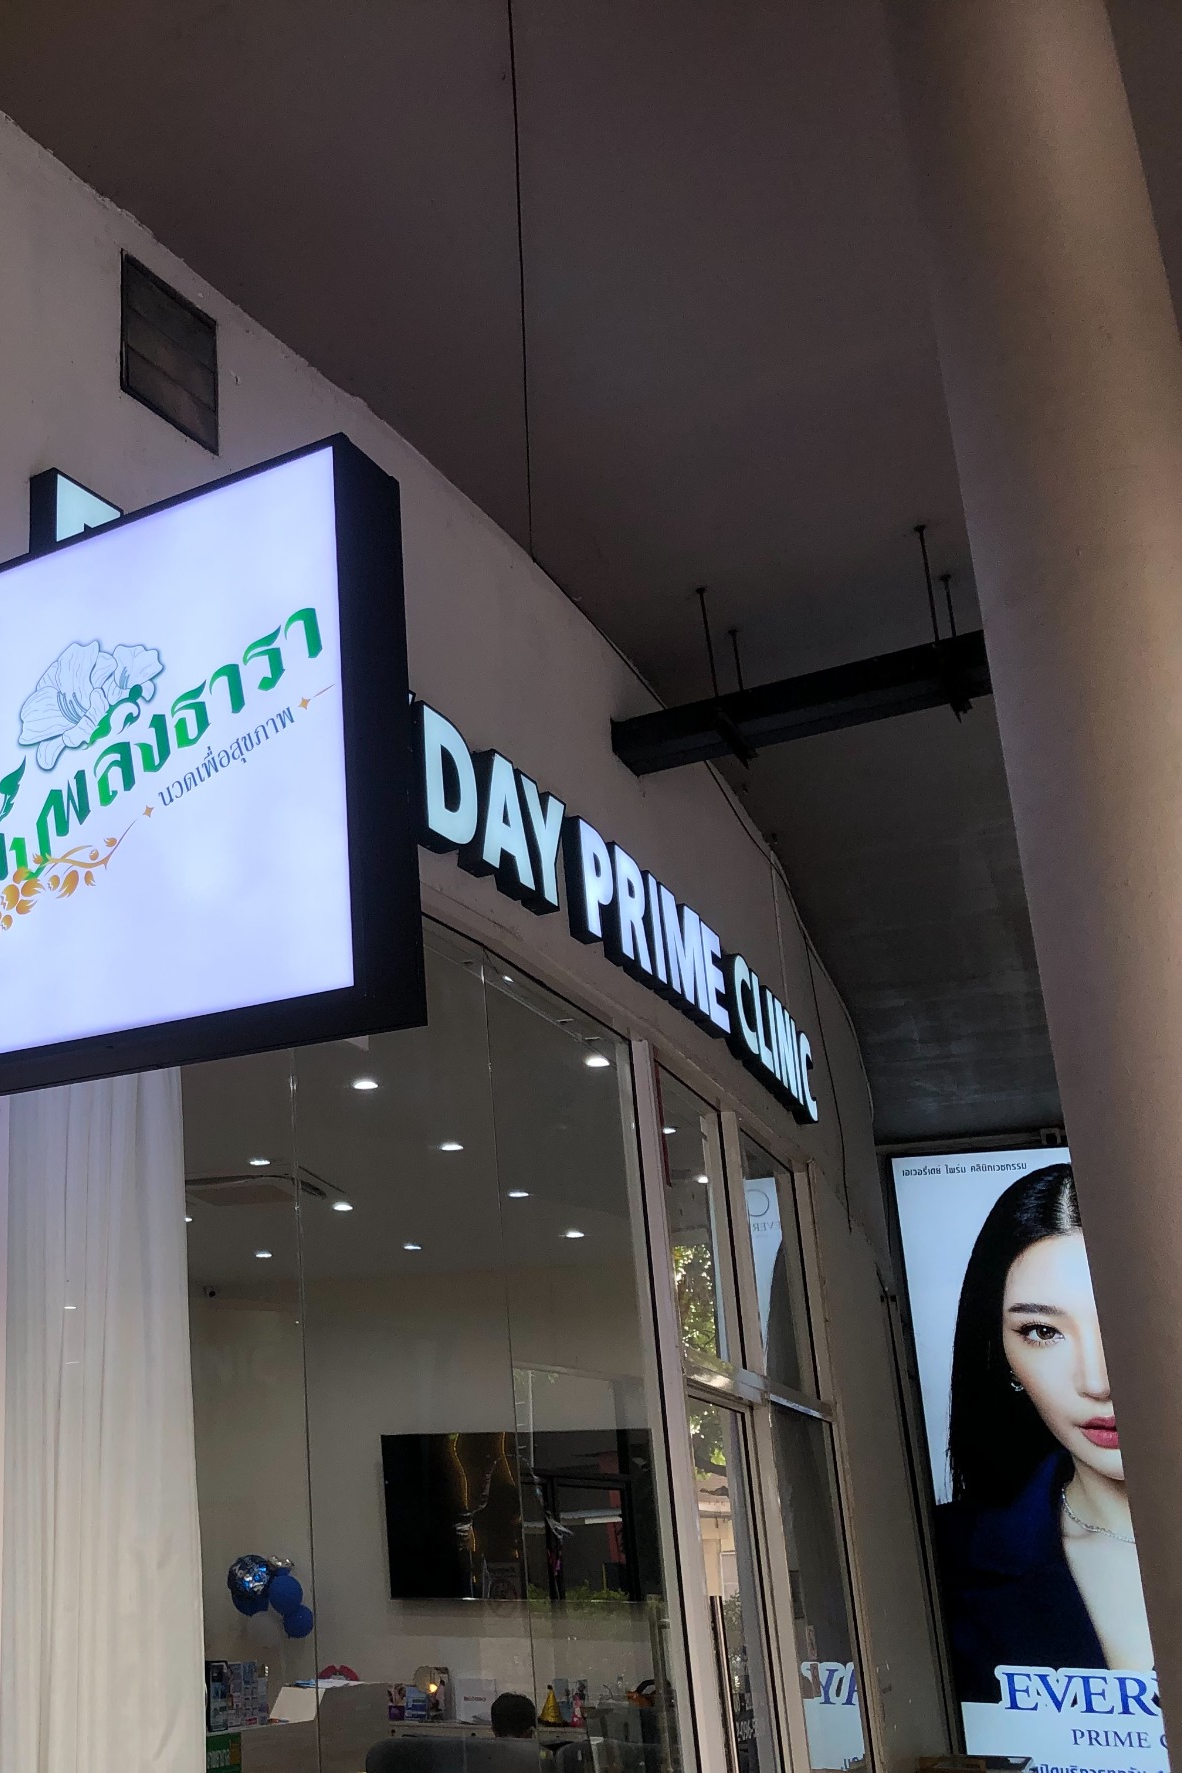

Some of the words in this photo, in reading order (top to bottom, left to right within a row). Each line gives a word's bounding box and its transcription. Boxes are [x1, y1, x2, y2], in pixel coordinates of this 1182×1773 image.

[158, 707, 296, 807] นวดเพื่อสุขภาพ
[575, 817, 731, 1036] PRIME
[733, 953, 818, 1123] CLINIC
[1002, 1671, 1159, 1717] EVER
[1071, 1728, 1152, 1749] PRIME
